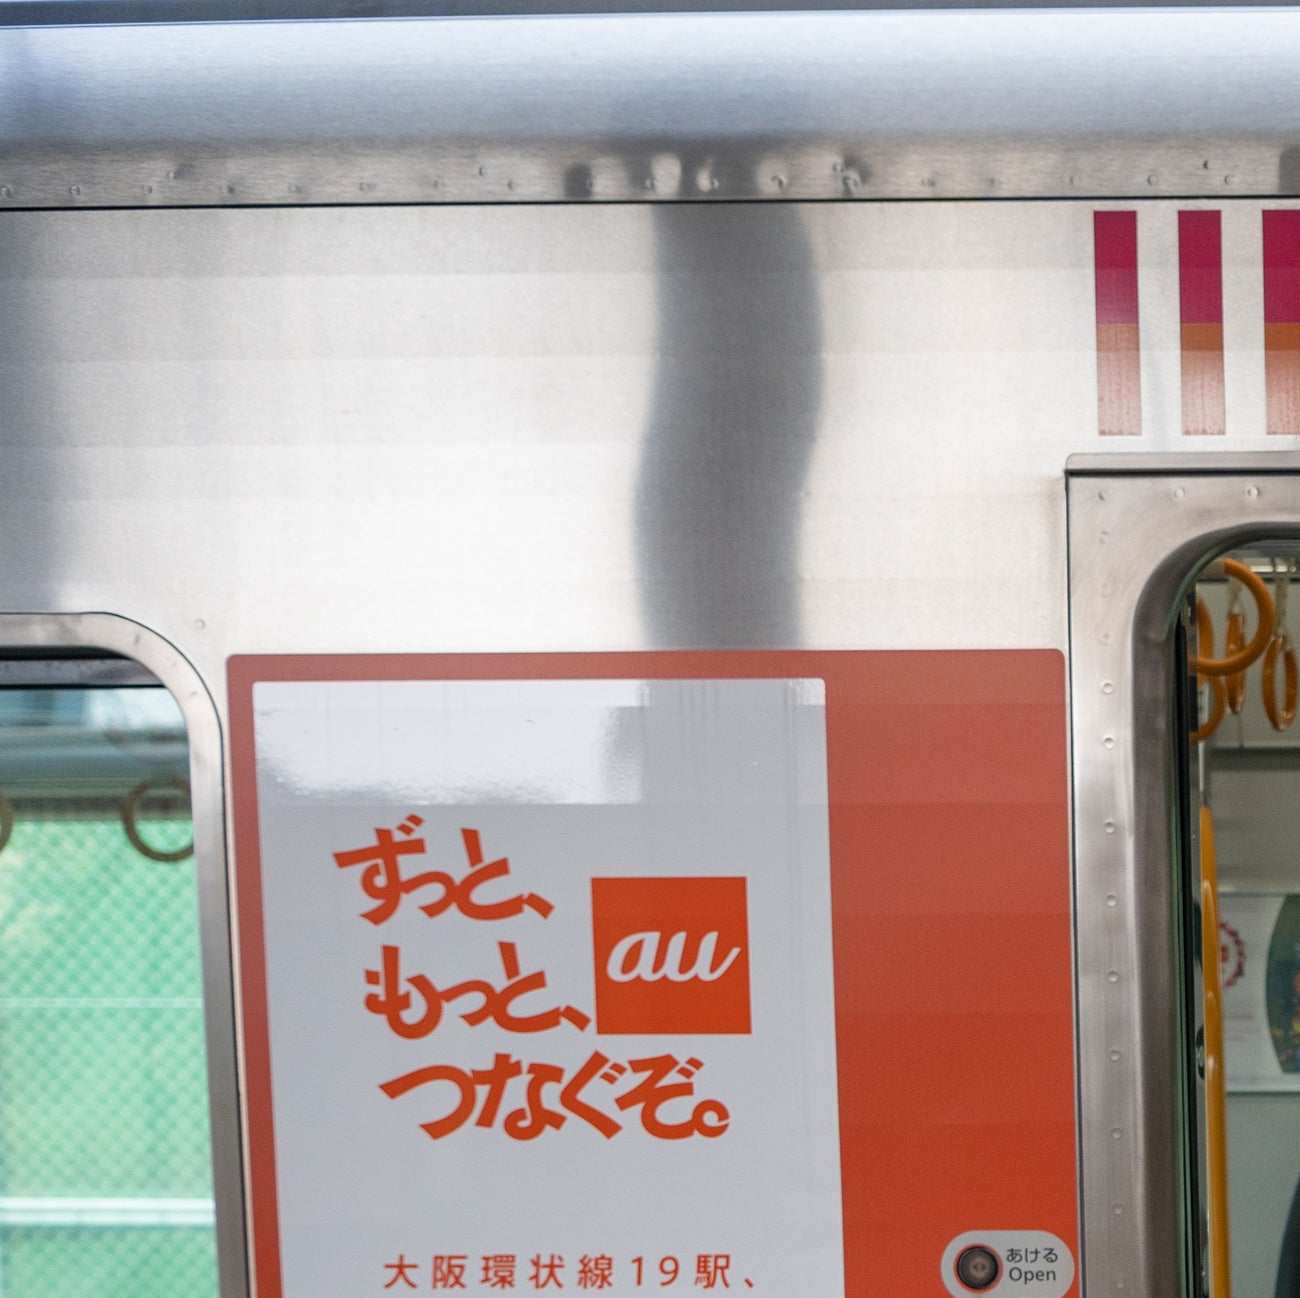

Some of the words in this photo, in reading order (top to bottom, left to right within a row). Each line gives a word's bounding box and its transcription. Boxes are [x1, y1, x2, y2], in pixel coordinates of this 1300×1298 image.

[333, 814, 554, 925] ずっと、
[606, 929, 741, 983] au
[364, 940, 591, 1041] もっと、
[378, 1050, 730, 1142] つなぐぞ。
[385, 1253, 757, 1290] 大阪環状線19駅、
[1006, 1247, 1059, 1264] あける
[1009, 1267, 1057, 1285] Open
